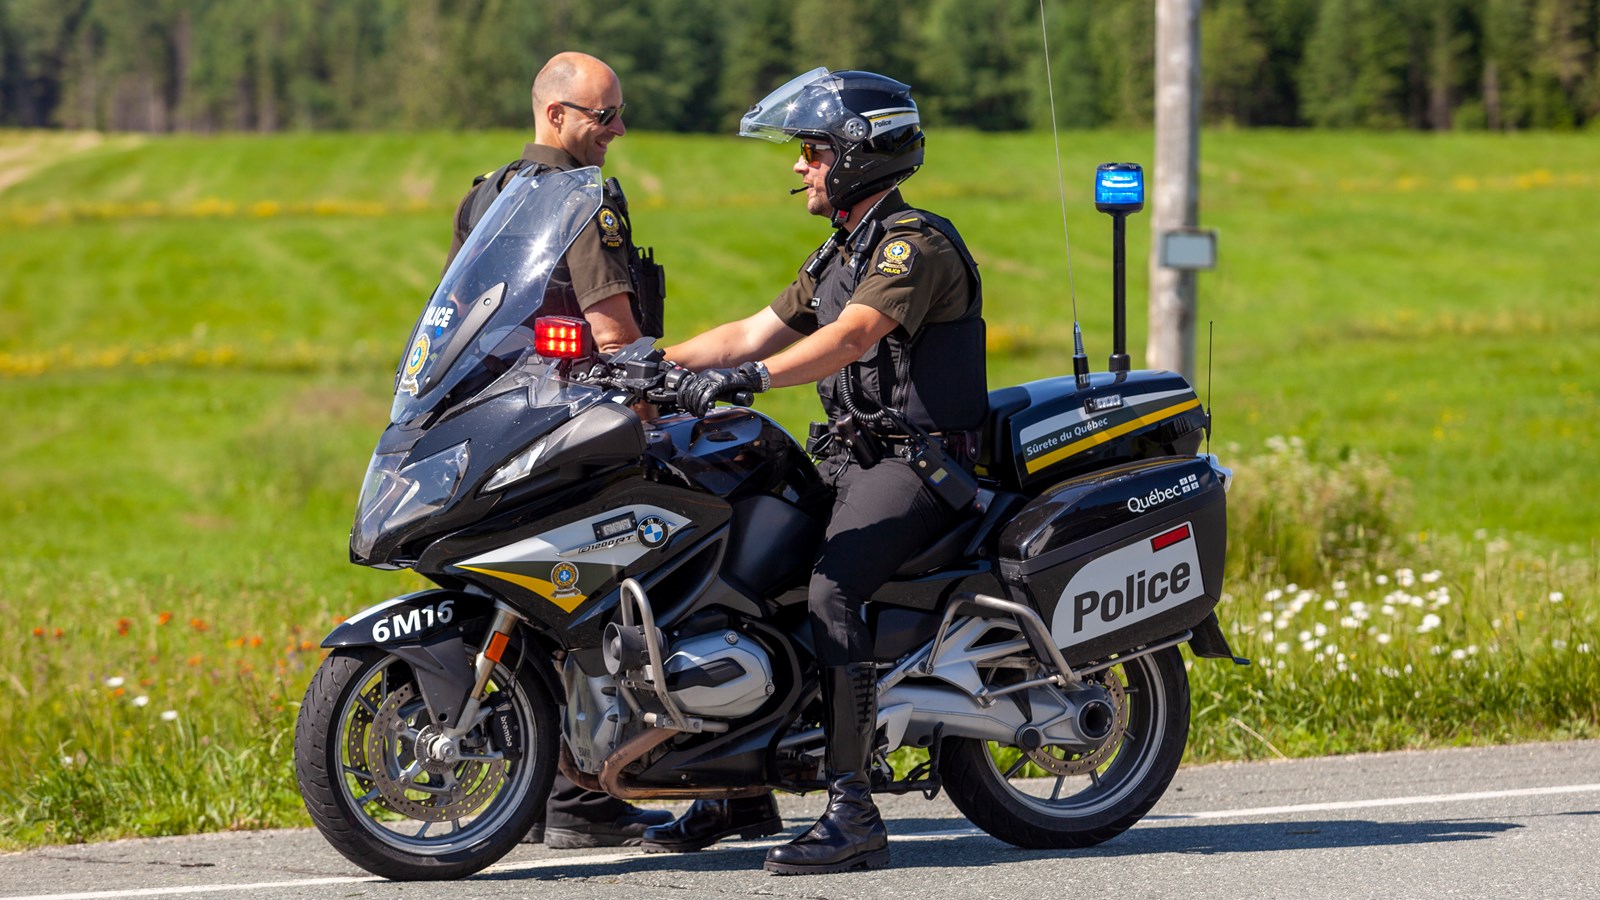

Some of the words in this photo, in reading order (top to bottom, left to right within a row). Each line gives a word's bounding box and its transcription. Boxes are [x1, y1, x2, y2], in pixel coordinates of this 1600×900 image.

[874, 120, 892, 128] Police
[1060, 431, 1072, 442] du
[1074, 417, 1108, 436] Québec
[1127, 484, 1182, 513] Québec
[640, 518, 664, 531] BMW
[1073, 562, 1191, 634] Police
[372, 600, 454, 642] 6M16
[500, 715, 512, 747] brembo
